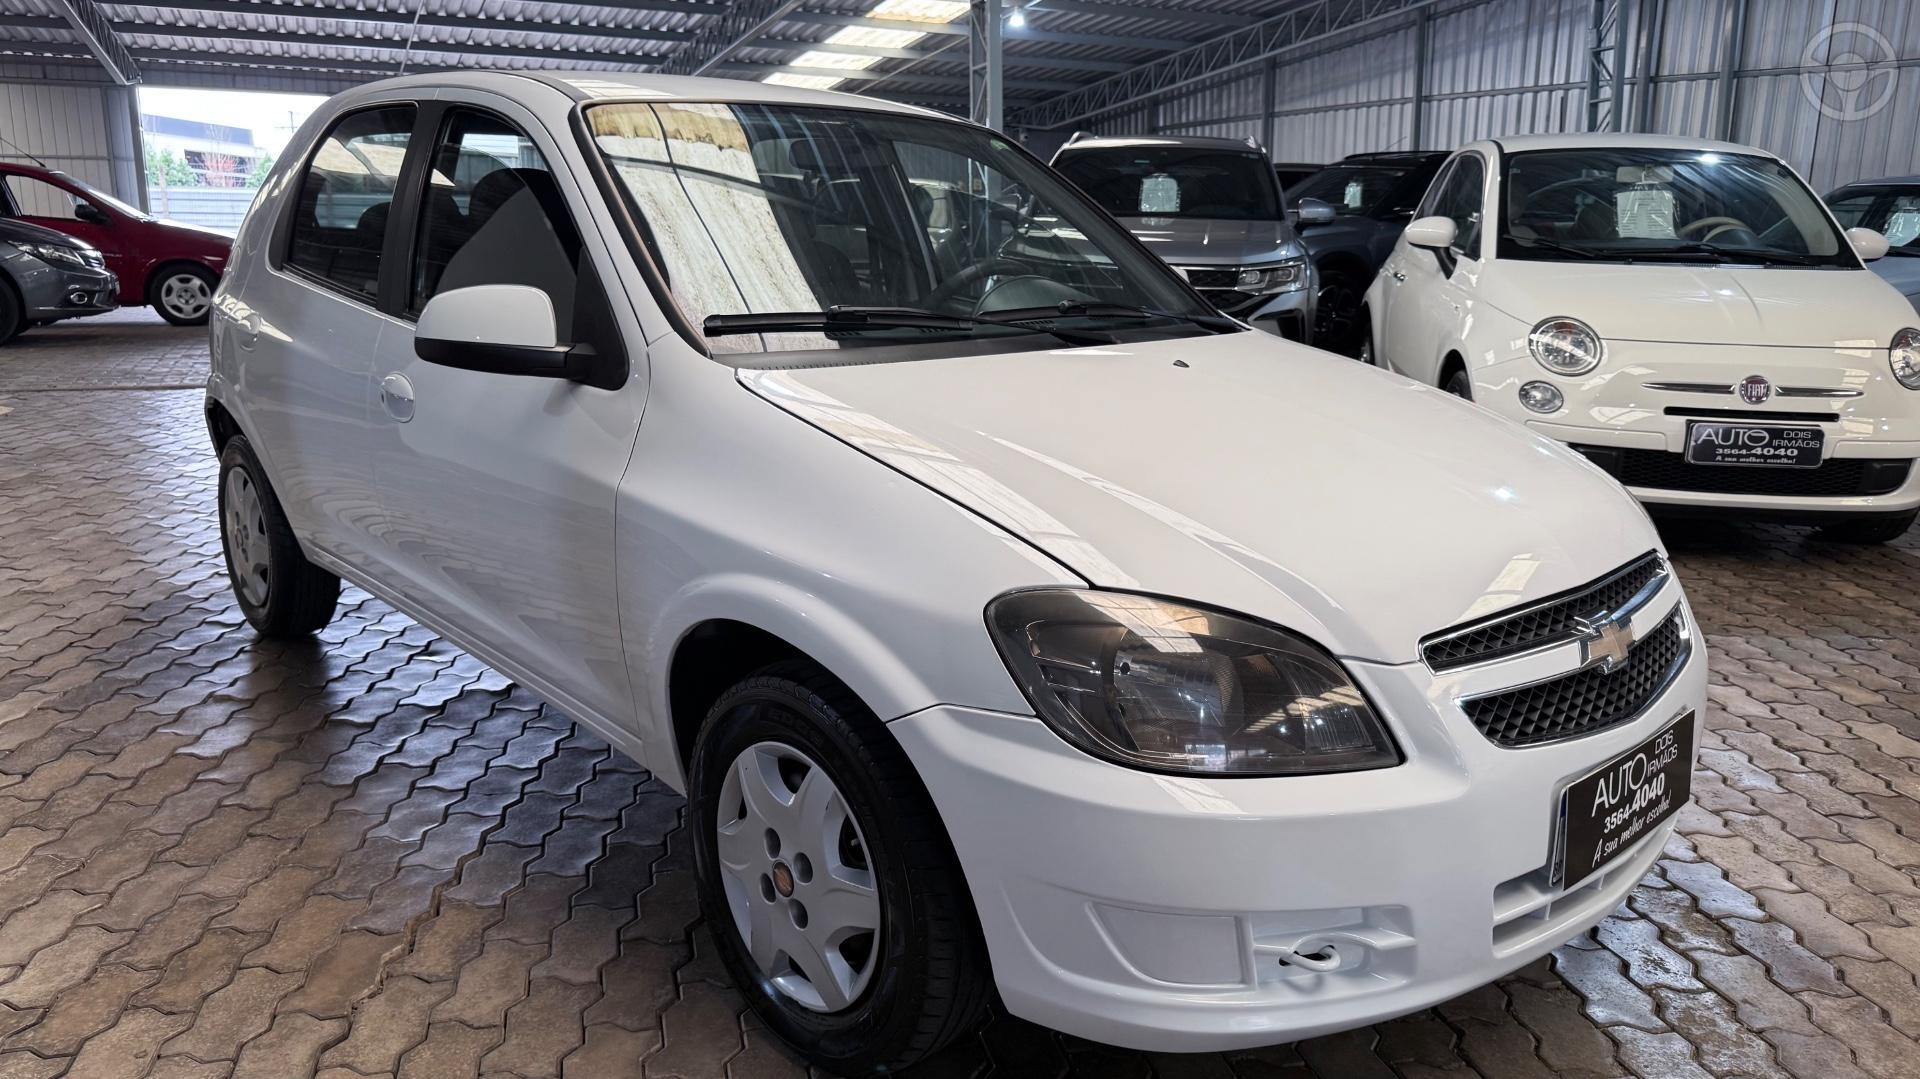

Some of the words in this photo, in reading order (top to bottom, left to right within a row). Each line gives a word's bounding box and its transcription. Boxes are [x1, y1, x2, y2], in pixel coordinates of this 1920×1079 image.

[1747, 383, 1768, 397] FIAT
[1697, 428, 1769, 446] AUTO
[1716, 447, 1798, 456] 3564-4040
[1655, 729, 1673, 754] DOIS
[1592, 752, 1647, 817] AUTO
[1604, 772, 1665, 833] 3564-4040
[1592, 838, 1602, 868] A
[1604, 837, 1618, 856] sua
